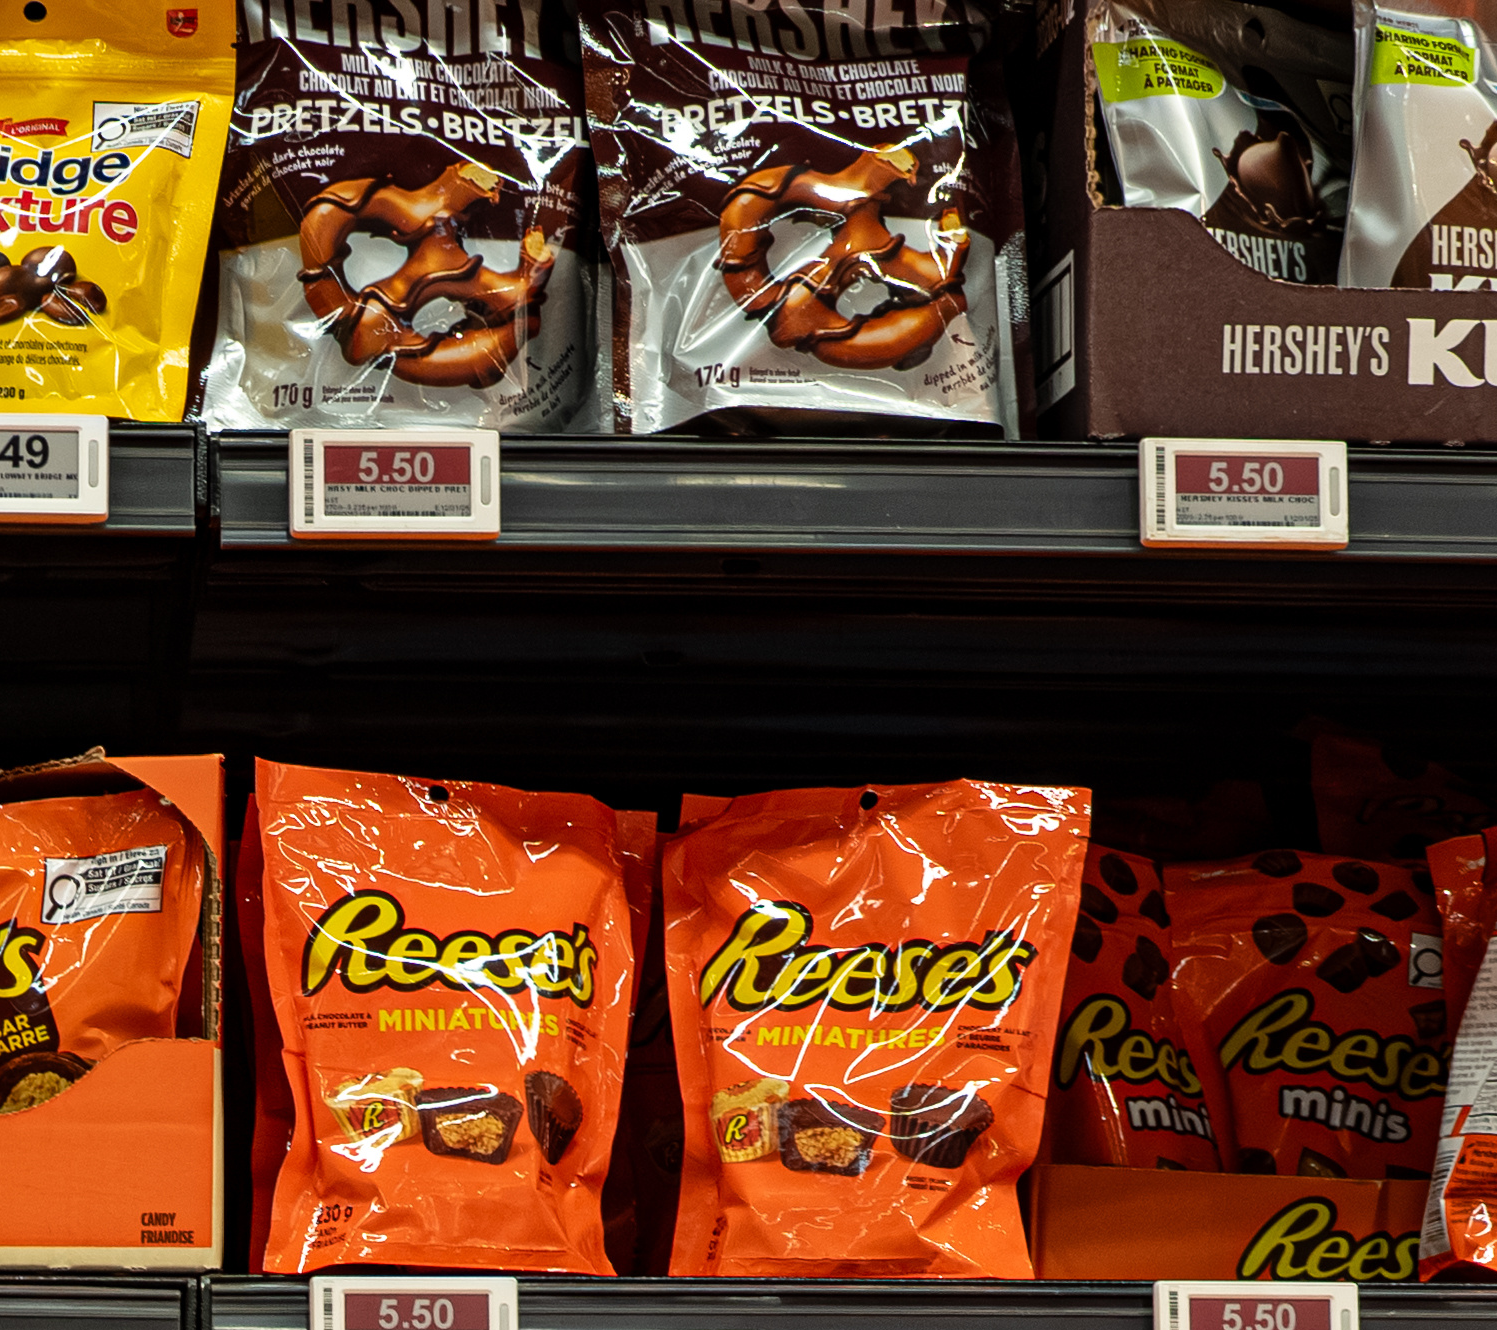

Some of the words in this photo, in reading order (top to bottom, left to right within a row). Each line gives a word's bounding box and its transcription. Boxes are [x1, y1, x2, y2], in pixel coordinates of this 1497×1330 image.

[1222, 324, 1389, 376] HERSHEY'S
[359, 453, 434, 483] 5.50
[1209, 461, 1284, 494] 5.50
[305, 892, 595, 1004] Reese's
[141, 1212, 176, 1228] CANDY
[141, 1229, 195, 1245] FRIANDISE
[377, 1299, 453, 1330] 5.50
